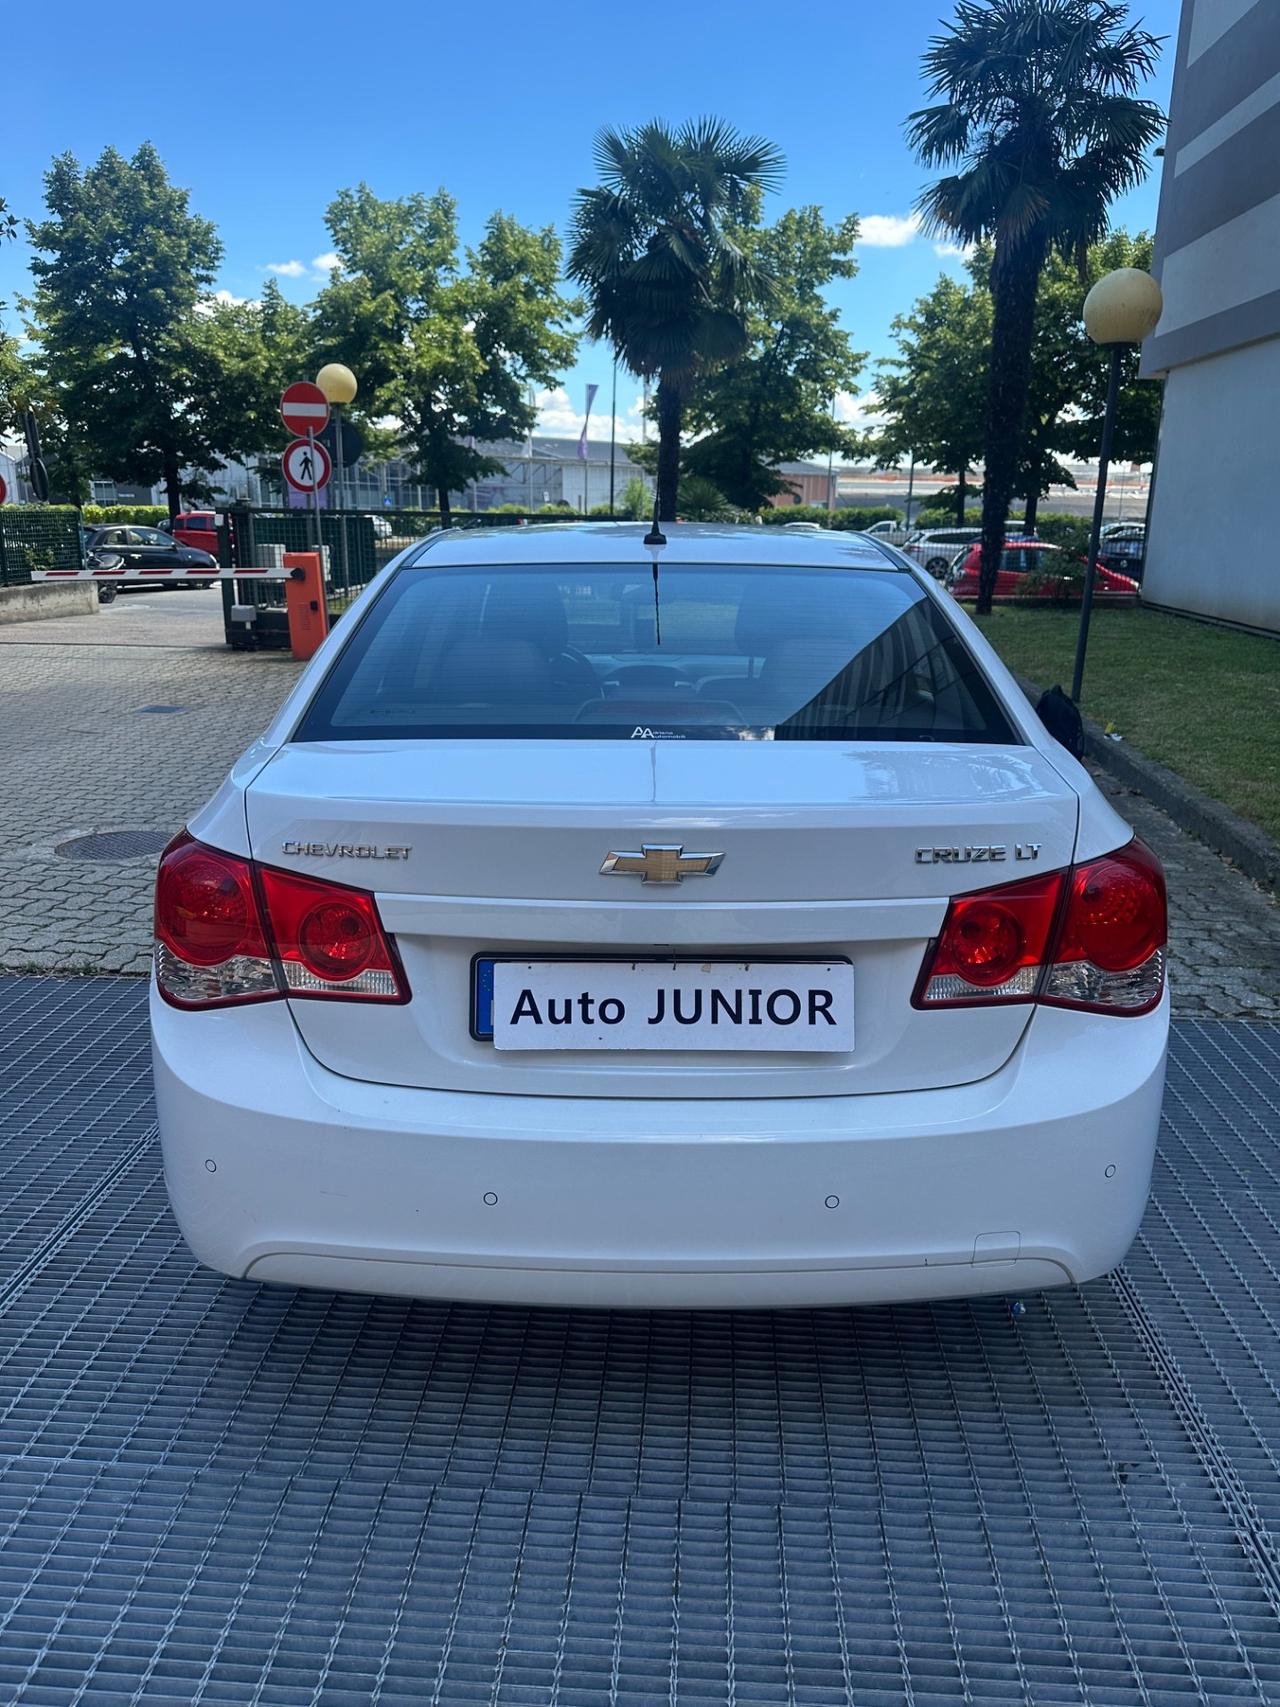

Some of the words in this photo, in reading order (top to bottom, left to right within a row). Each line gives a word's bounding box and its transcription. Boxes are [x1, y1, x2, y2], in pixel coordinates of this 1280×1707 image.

[282, 841, 413, 860] CHEVROLET
[915, 845, 1007, 864] CRUZE
[1014, 843, 1042, 860] LT
[510, 989, 626, 1025] Auto
[647, 989, 837, 1025] JUNIOR
